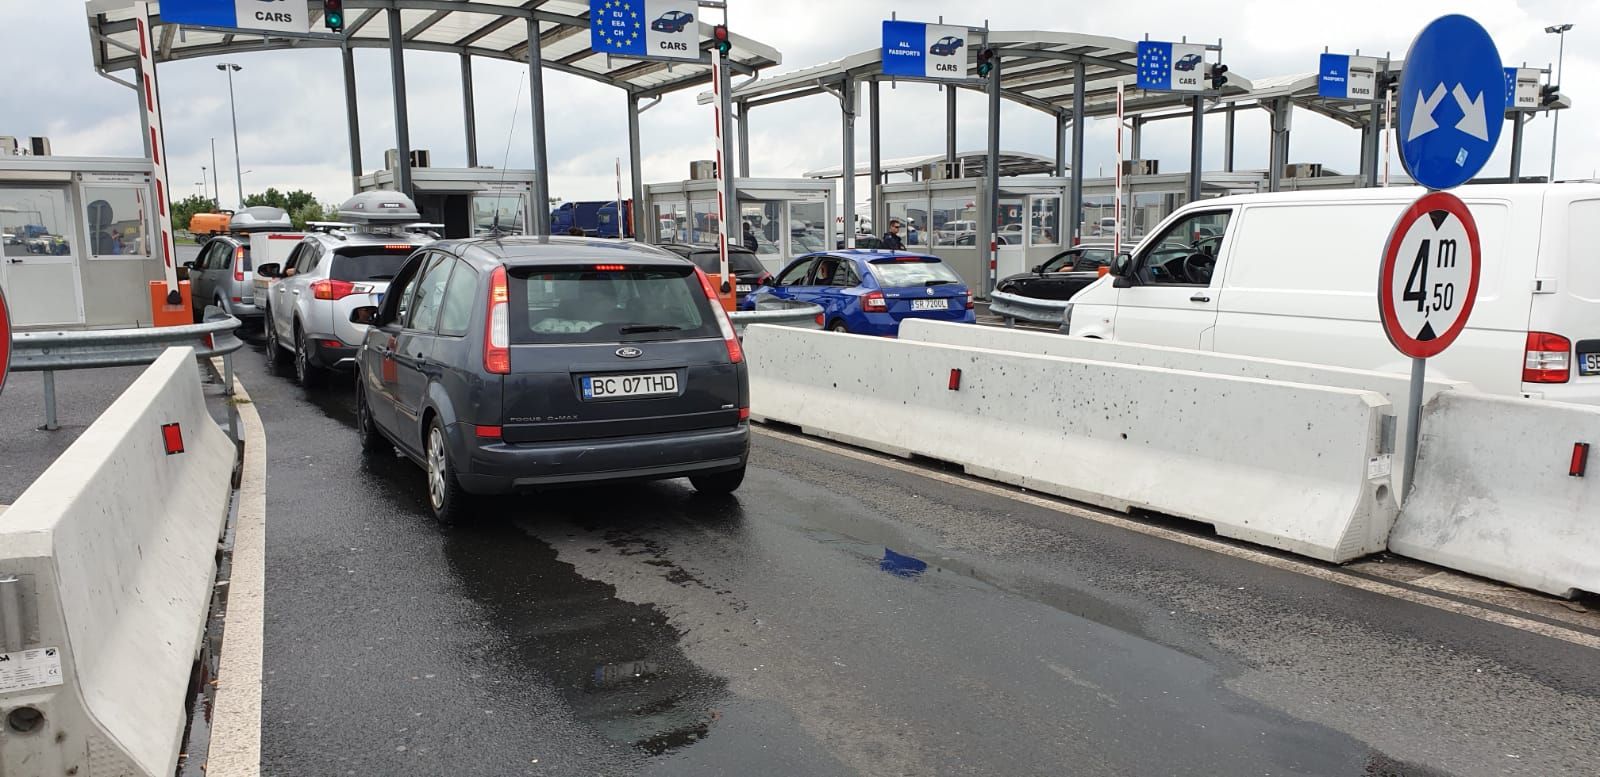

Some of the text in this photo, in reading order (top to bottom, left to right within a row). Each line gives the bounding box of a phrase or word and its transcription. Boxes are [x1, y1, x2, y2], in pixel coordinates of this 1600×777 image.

[255, 11, 292, 23] CARS
[660, 41, 687, 51] CARS
[888, 49, 921, 57] PASSPORTS
[936, 63, 958, 72] CARS
[1179, 77, 1197, 85] CARS
[1352, 87, 1370, 95] BUSES
[1436, 239, 1456, 268] m
[592, 379, 616, 396] BC
